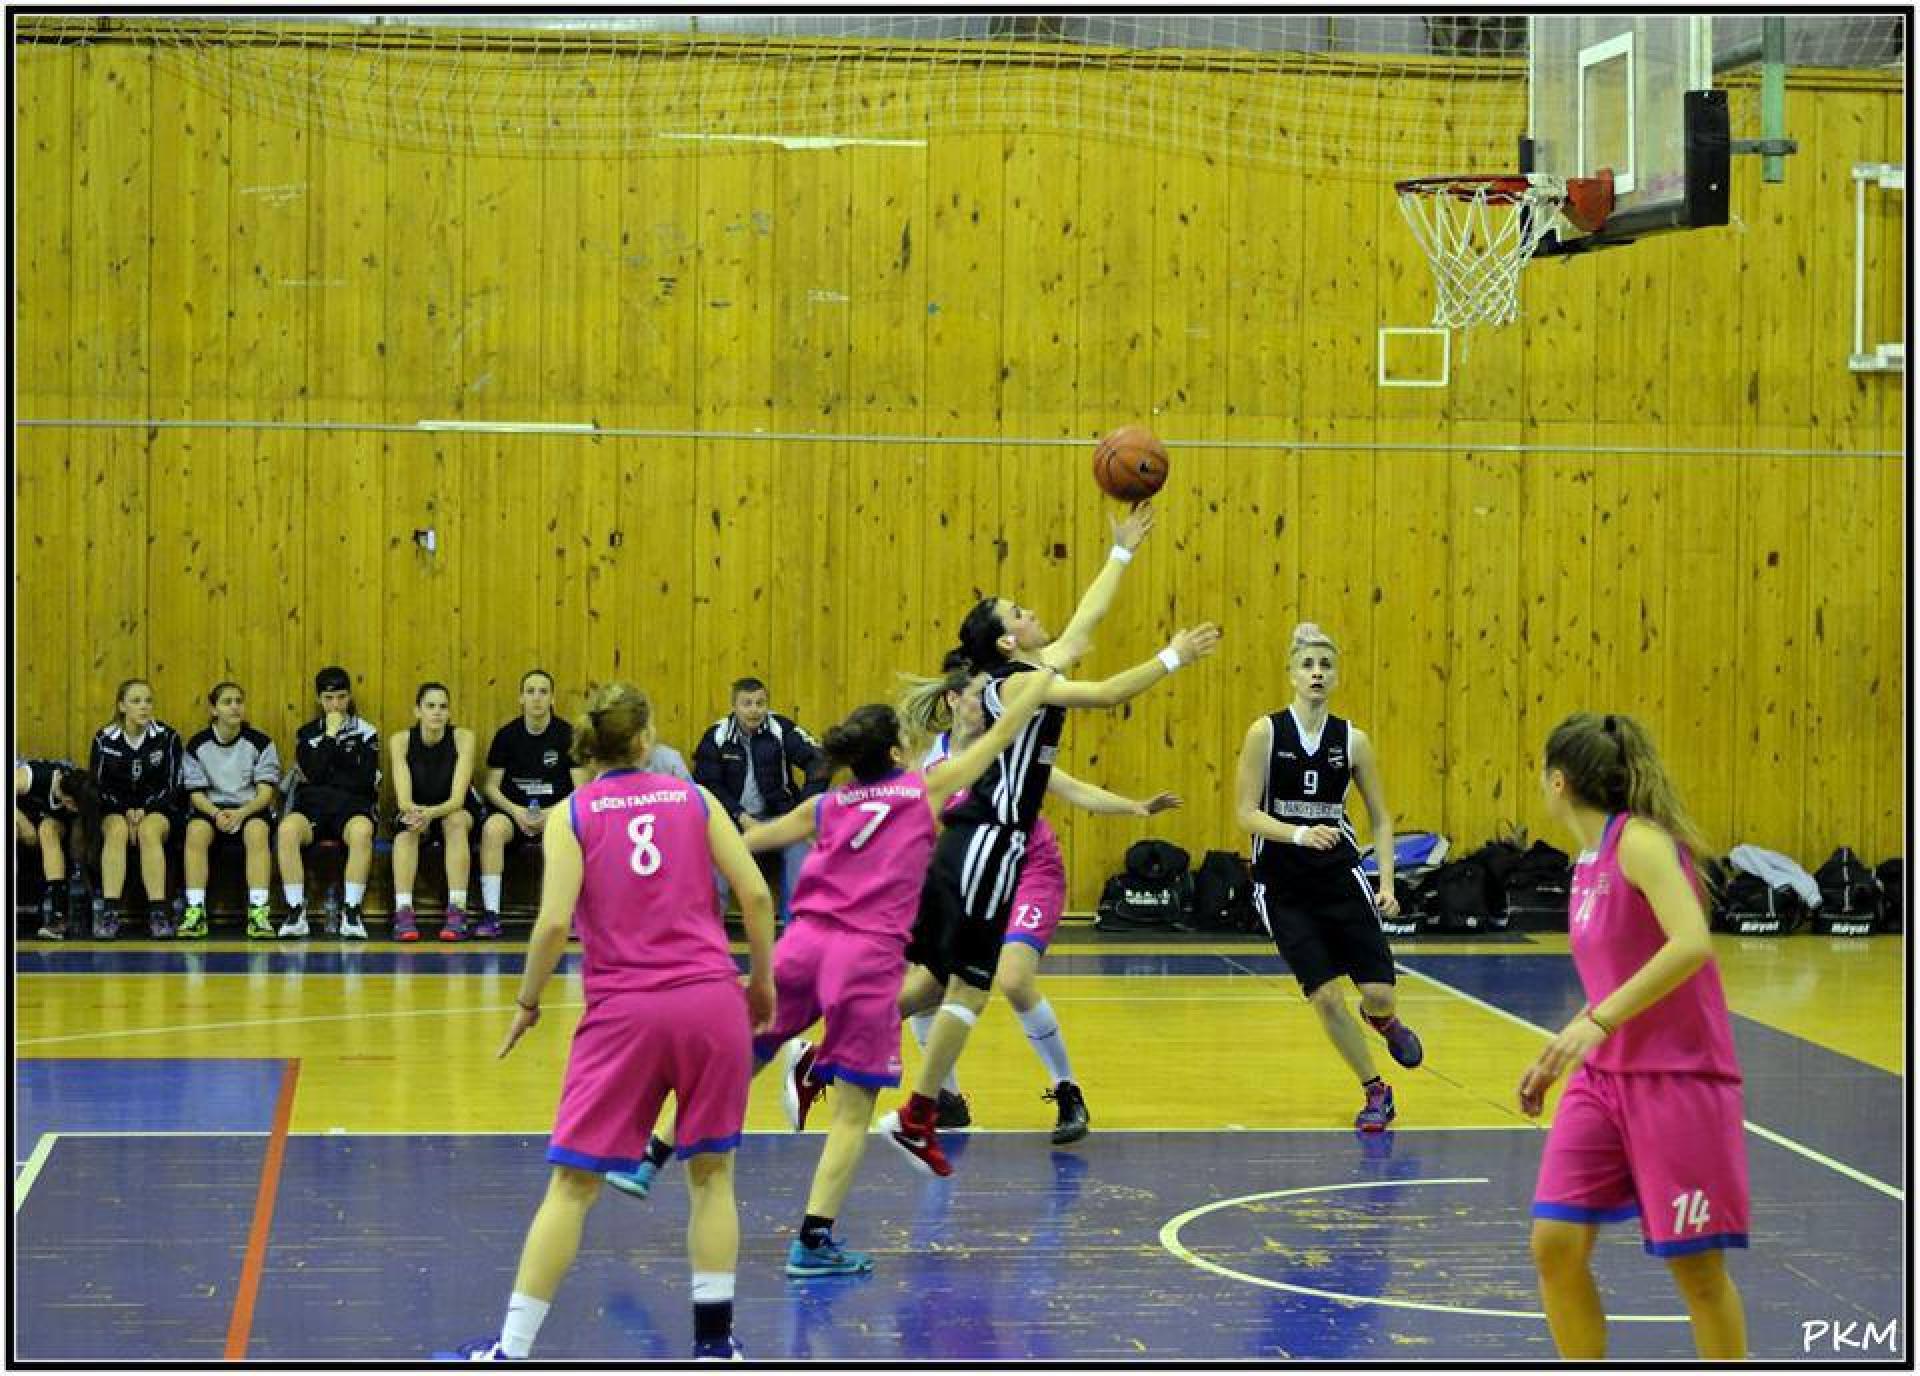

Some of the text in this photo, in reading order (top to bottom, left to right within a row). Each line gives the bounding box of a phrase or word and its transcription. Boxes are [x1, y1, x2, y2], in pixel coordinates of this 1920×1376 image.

[1303, 769, 1319, 795] 9
[628, 814, 661, 876] 8
[852, 801, 889, 849] 7
[1015, 903, 1042, 929] 13
[1672, 1190, 1710, 1235] 14
